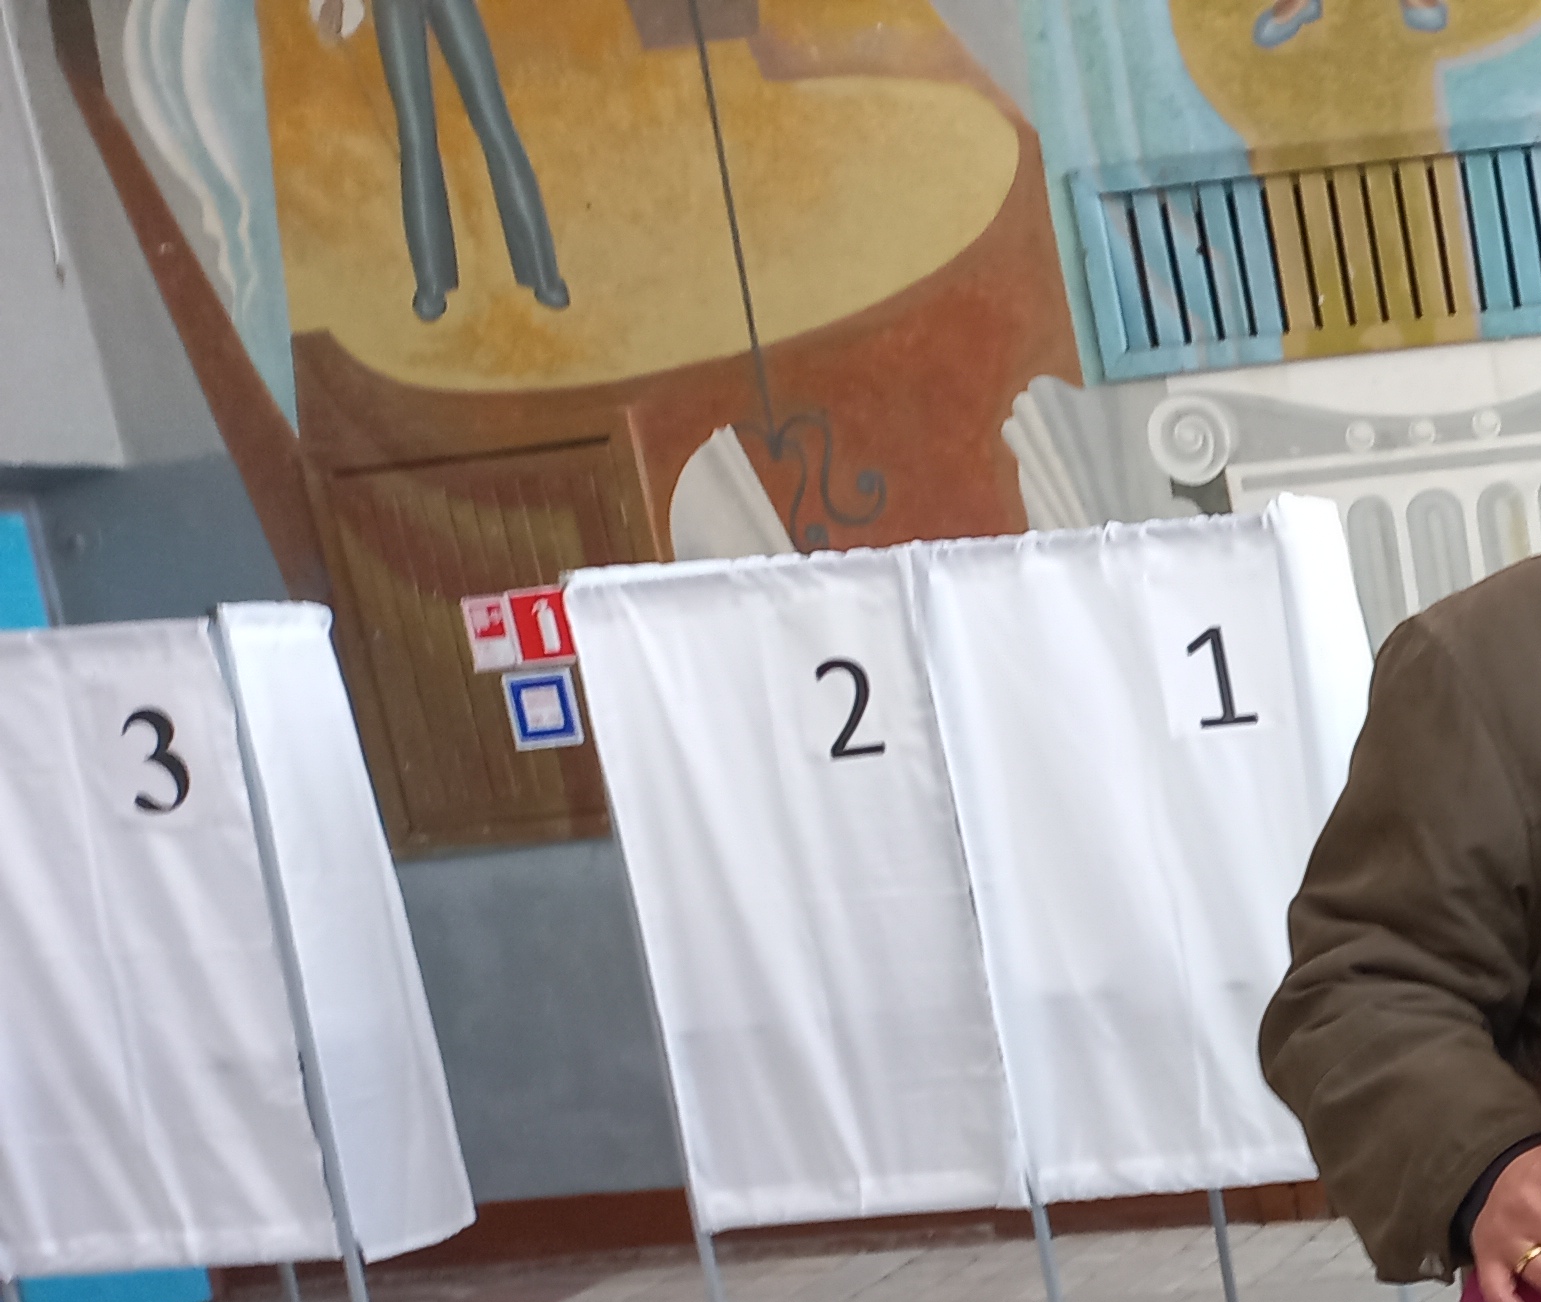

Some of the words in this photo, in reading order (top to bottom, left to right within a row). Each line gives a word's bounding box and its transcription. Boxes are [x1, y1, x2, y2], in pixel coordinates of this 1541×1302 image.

[814, 658, 886, 760] 2
[1186, 626, 1259, 729] 1
[121, 708, 191, 814] 3
